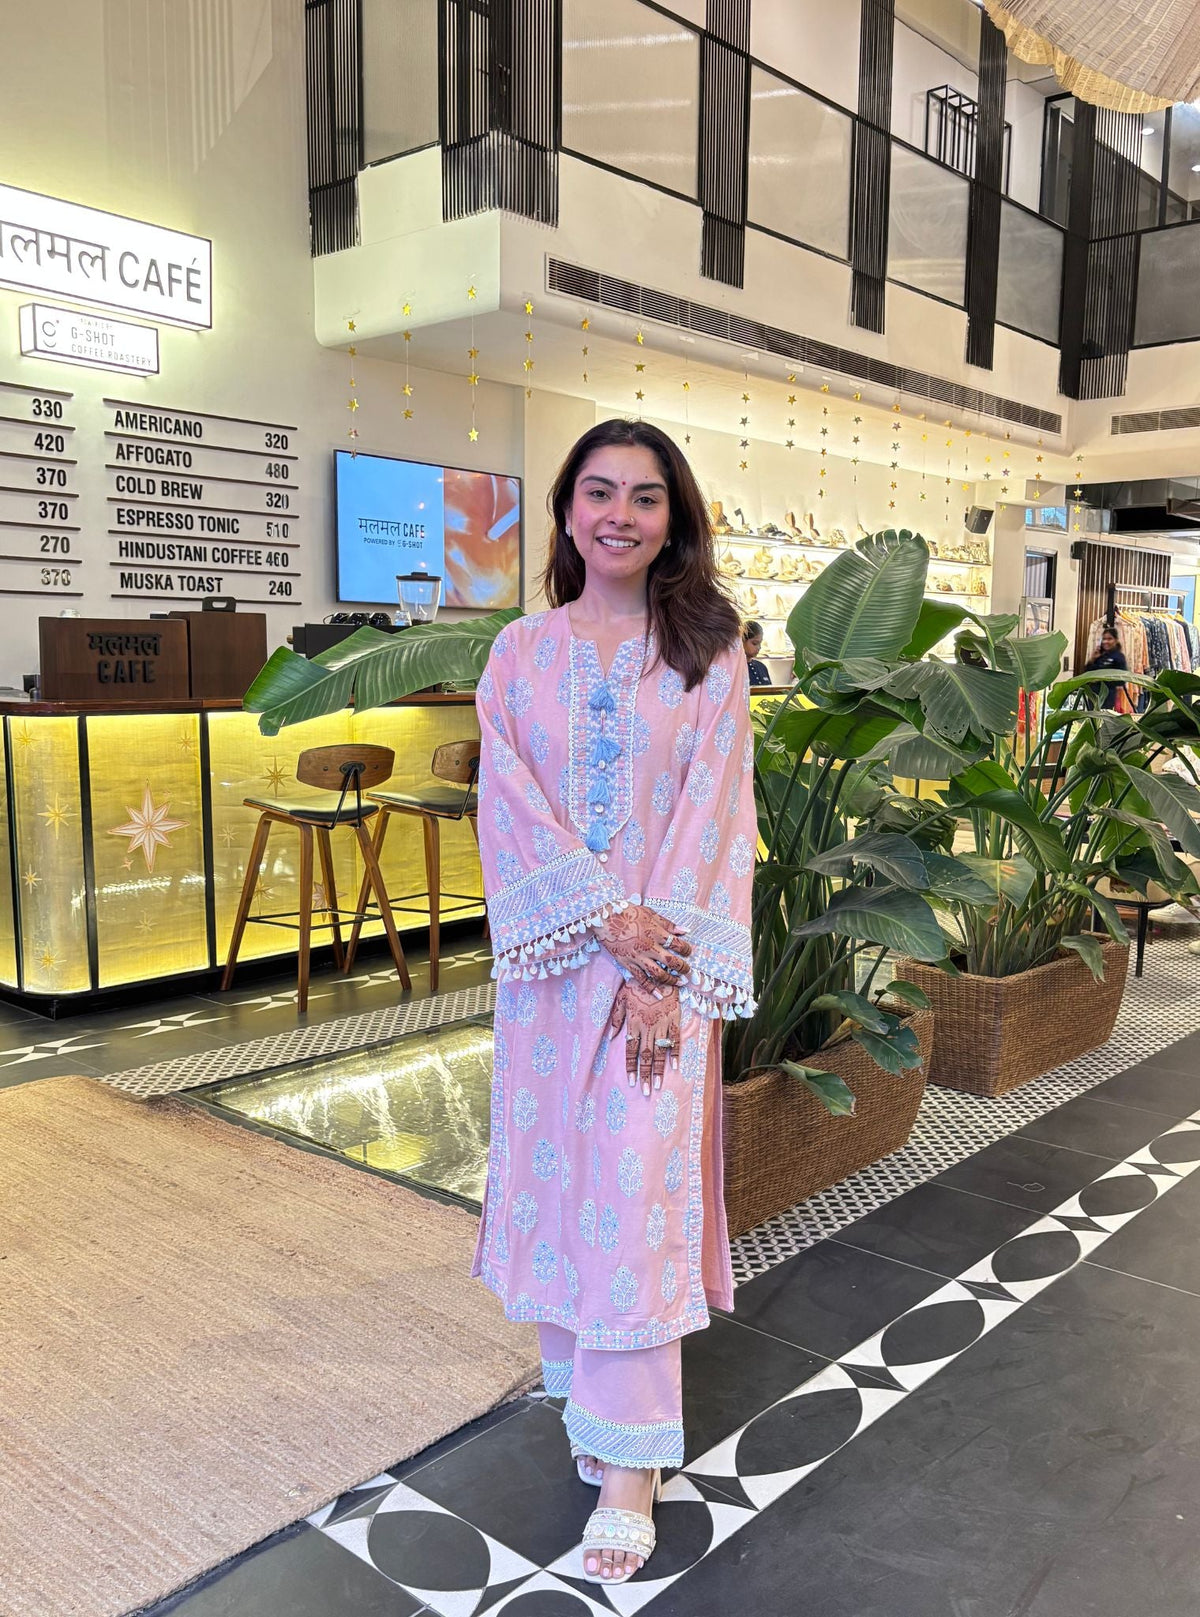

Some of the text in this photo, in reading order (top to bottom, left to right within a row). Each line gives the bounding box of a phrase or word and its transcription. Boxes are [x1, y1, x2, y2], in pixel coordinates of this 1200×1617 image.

[0, 220, 202, 304] लमल CAFÉ
[71, 327, 116, 347] G-SHOT
[71, 343, 152, 367] COFFEE ROASTERY
[32, 398, 63, 419] 330
[114, 410, 289, 450] AMERICANO 320
[34, 433, 65, 453] 420
[115, 443, 289, 479] AFFOGATO 480
[36, 467, 67, 487] 370
[115, 475, 289, 509] COLD BREW 320
[38, 501, 69, 520] 370
[116, 508, 289, 538] ESPRESSO TONIC 510
[358, 518, 425, 539] मलमल CAFE
[40, 535, 70, 554] 270
[118, 540, 289, 567] HINDUSTANI COFFEE 460
[363, 537, 423, 549] POWERED BY G-SHOT
[40, 567, 72, 586] 370
[120, 572, 292, 596] MUSKA TOAST 240
[87, 632, 162, 656] मलमल
[97, 660, 156, 684] CAFE
